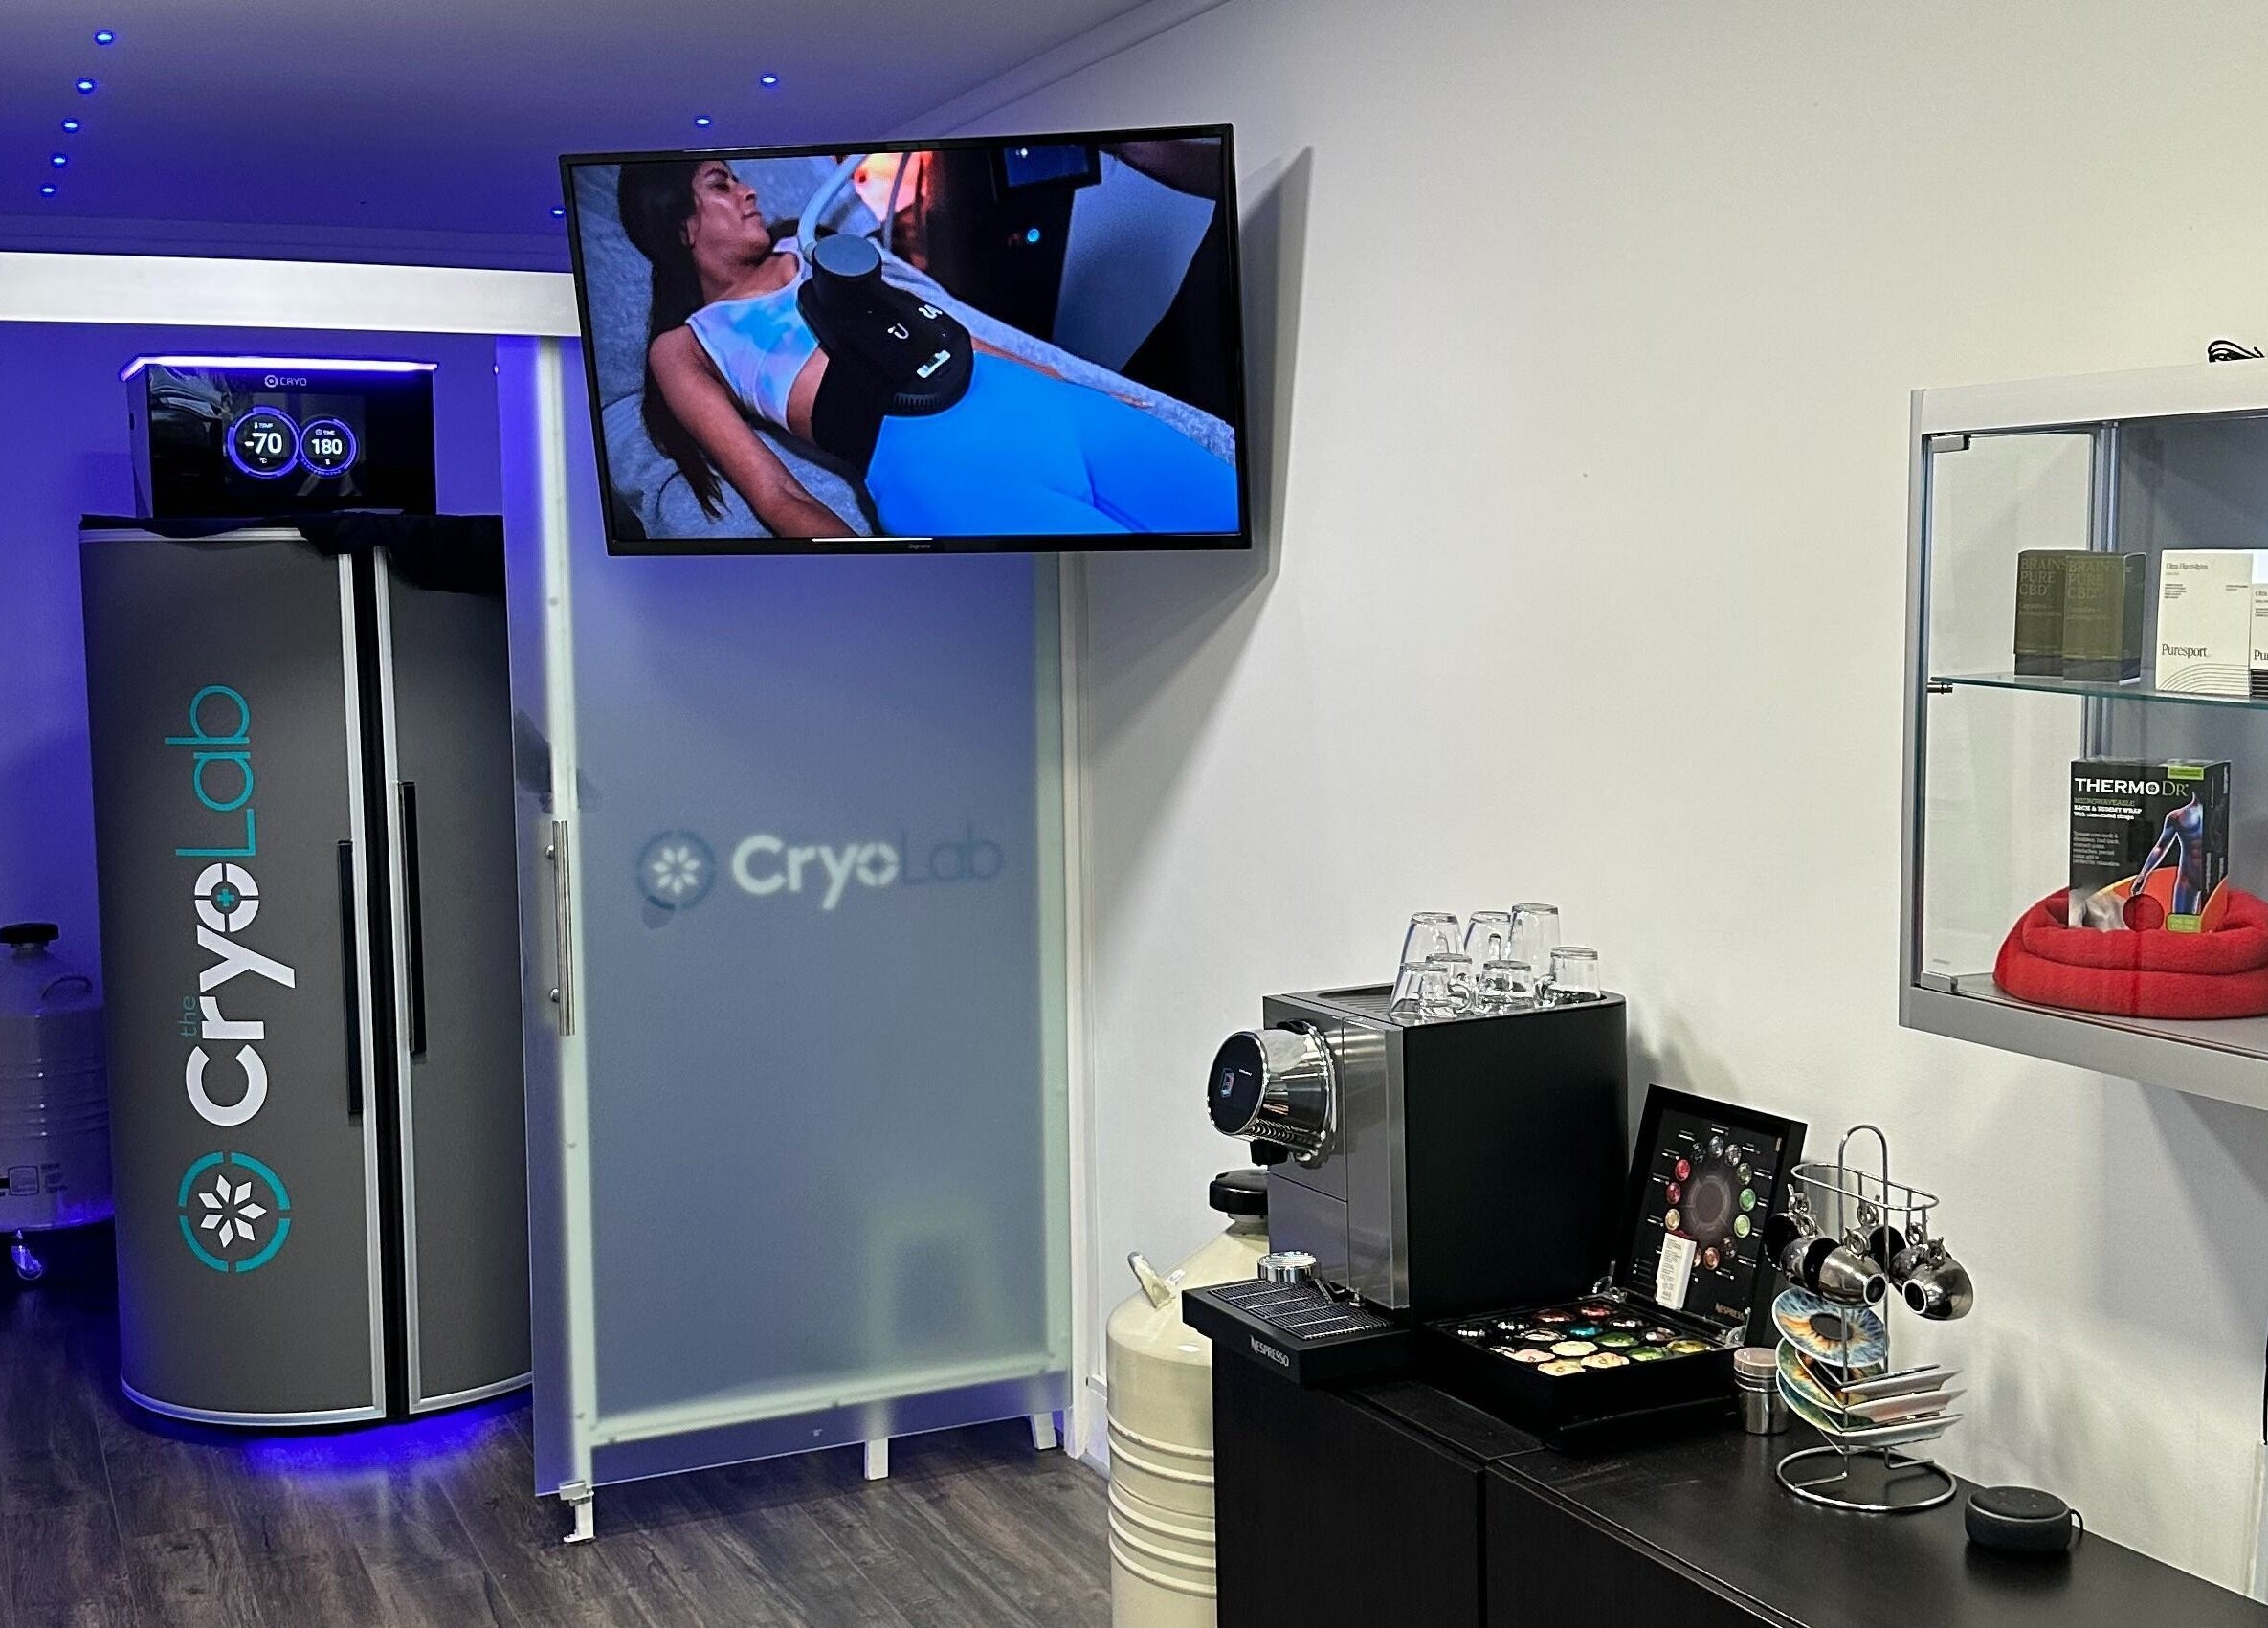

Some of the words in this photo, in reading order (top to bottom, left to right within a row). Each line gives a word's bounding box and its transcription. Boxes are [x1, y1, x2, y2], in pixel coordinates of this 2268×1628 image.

[244, 432, 282, 455] -70
[311, 438, 343, 455] 180
[2019, 571, 2056, 584] PURE
[2018, 583, 2048, 596] CBD
[2162, 643, 2208, 659] Puresport
[178, 995, 197, 1038] the
[1250, 1335, 1291, 1367] NESPRESSO
